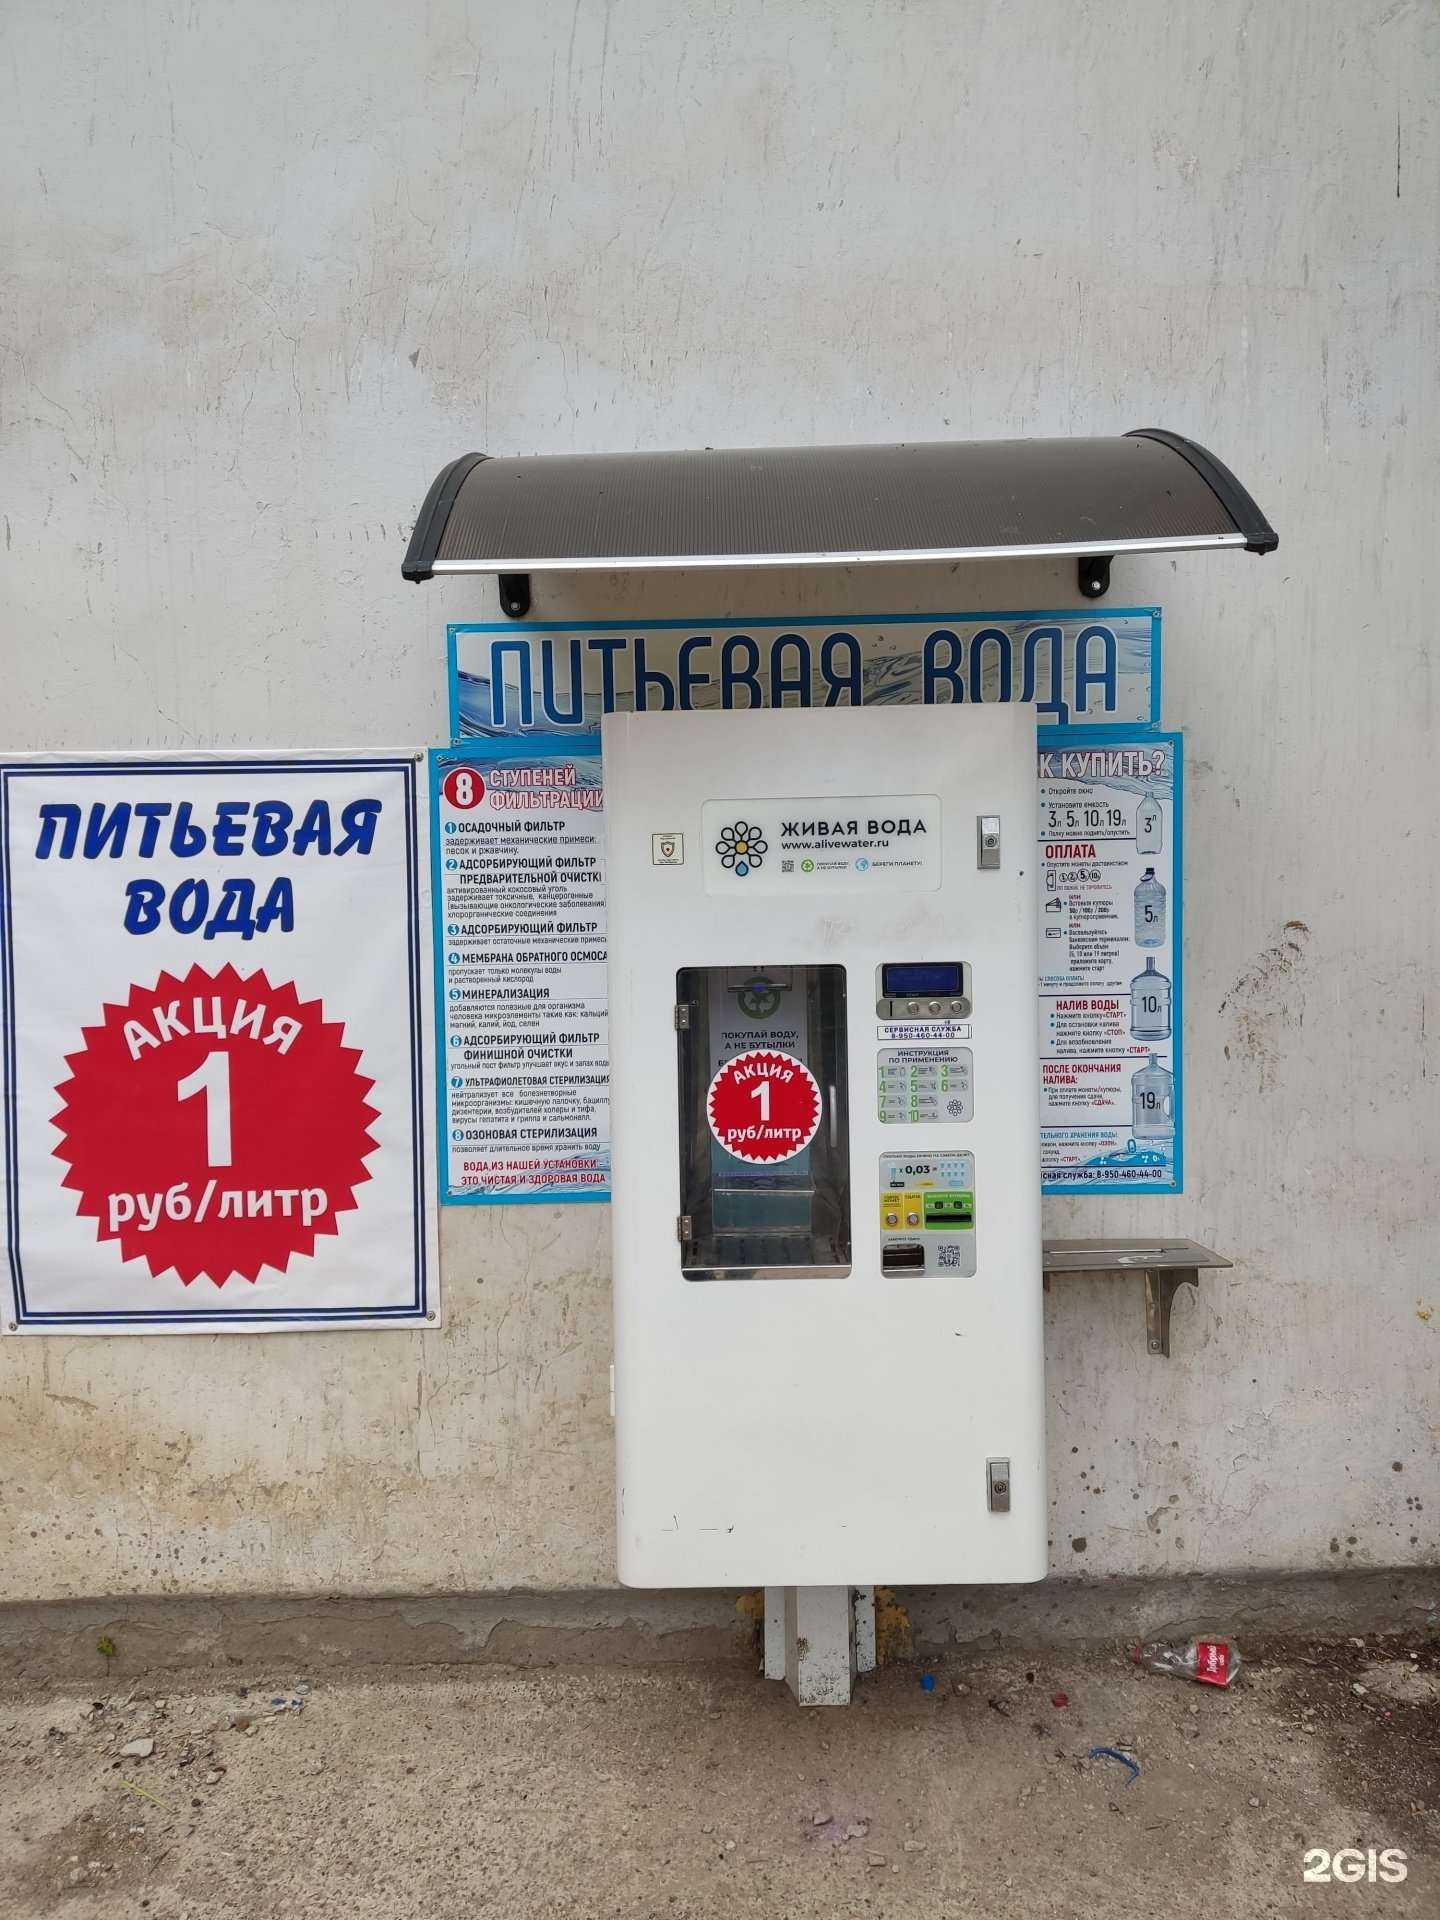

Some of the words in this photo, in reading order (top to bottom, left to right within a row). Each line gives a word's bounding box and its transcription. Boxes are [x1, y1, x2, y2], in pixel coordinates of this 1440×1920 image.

[490, 632, 862, 726] ПИТЬЕВАЯ
[922, 625, 1118, 724] ВОДА
[1062, 750, 1165, 778] КУПИТЬ?
[489, 765, 577, 787] СТУПЕНЕЙ
[456, 772, 474, 805] 8
[35, 800, 383, 859] ПИТЬЕВАЯ
[459, 820, 521, 834] ОСАДОЧНЫЙ
[524, 821, 566, 832] ФИЛЬТР
[781, 820, 858, 837] ЖИВАЯ
[868, 819, 927, 836] ВОДА
[446, 837, 498, 846] задерживает
[500, 836, 557, 844] механические
[781, 839, 889, 850] www.alivewater.ru
[1046, 844, 1096, 858] ОПЛАТА
[460, 856, 552, 870] АДСОРБИРУЮЩИЙ
[555, 857, 597, 868] ФИЛЬТР
[460, 871, 558, 885] ПРЕДВАРИТЕЛЬНОЙ
[560, 872, 602, 883] ОЧИСТК
[447, 886, 506, 894] активированный
[448, 894, 493, 902] задерживает
[538, 892, 593, 901] канцерогенные
[124, 877, 295, 941] ВОДА
[500, 901, 557, 909] онкологические
[462, 920, 554, 935] АДСОРБИРУЮЩИЙ
[556, 922, 598, 933] ФИЛЬТР
[462, 953, 514, 963] МЕМБРАНА
[516, 952, 568, 962] ОБРАТНОГО
[570, 951, 608, 961] ОСМОСА
[462, 988, 550, 1000] МИНЕРАЛИЗАЦИЯ
[1056, 1000, 1088, 1010] НАЛИВ
[1091, 1000, 1119, 1012] ВОДЫ
[484, 1012, 540, 1020] микроэлементы
[122, 996, 303, 1061] АКЦИЯ
[722, 1030, 767, 1039] ПОКУПАЙ
[770, 1031, 798, 1039] ВОДУ,
[464, 1032, 556, 1046] АДСОРБИРУЮЩИЙ
[559, 1033, 600, 1044] ФИЛЬТР
[464, 1048, 525, 1060] ФИНИШНОЙ
[528, 1048, 572, 1059] ОЧИСТКИ
[733, 1063, 794, 1084] АКЦИЯ
[879, 1066, 885, 1078] 1
[911, 1066, 918, 1077] 2
[942, 1065, 948, 1077] 3
[1042, 1064, 1070, 1074] ПОСЛЕ
[1072, 1064, 1121, 1072] ОКОНЧАНИЯ
[466, 1076, 547, 1087] УЛЬТРАФИОЛЕТОВАЯ
[1043, 1075, 1078, 1084] НАЛИВА:
[879, 1081, 886, 1092] 4
[911, 1080, 918, 1092] 5
[942, 1080, 948, 1092] 6
[452, 1090, 498, 1099] нейтрализует
[752, 1081, 770, 1121] 1
[880, 1096, 886, 1107] 7
[912, 1096, 918, 1107] 8
[177, 1051, 232, 1168] 1
[880, 1111, 886, 1122] 9
[908, 1110, 918, 1122] 10
[466, 1130, 517, 1140] ОЗОНОВАЯ
[520, 1128, 598, 1139] СТЕРИЛИЗАЦИЯ
[728, 1125, 802, 1142] руб/литр
[490, 1144, 529, 1153] длительное
[584, 1144, 600, 1152] воду
[492, 1161, 504, 1170] ИЗ
[506, 1159, 540, 1170] НАШЕЙ
[544, 1160, 596, 1170] УСТАНОВКИ
[905, 1165, 930, 1175] 0,03
[462, 1176, 478, 1185] ЭТО
[482, 1176, 516, 1185] ЧИСТАЯ
[520, 1176, 526, 1184] И
[528, 1174, 577, 1185] ЗДОРОВАЯ
[580, 1174, 606, 1184] ВОДА
[1063, 1170, 1094, 1180] служба:
[1096, 1169, 1162, 1179] 8-950-460-44-00
[108, 1179, 328, 1232] руб/литр
